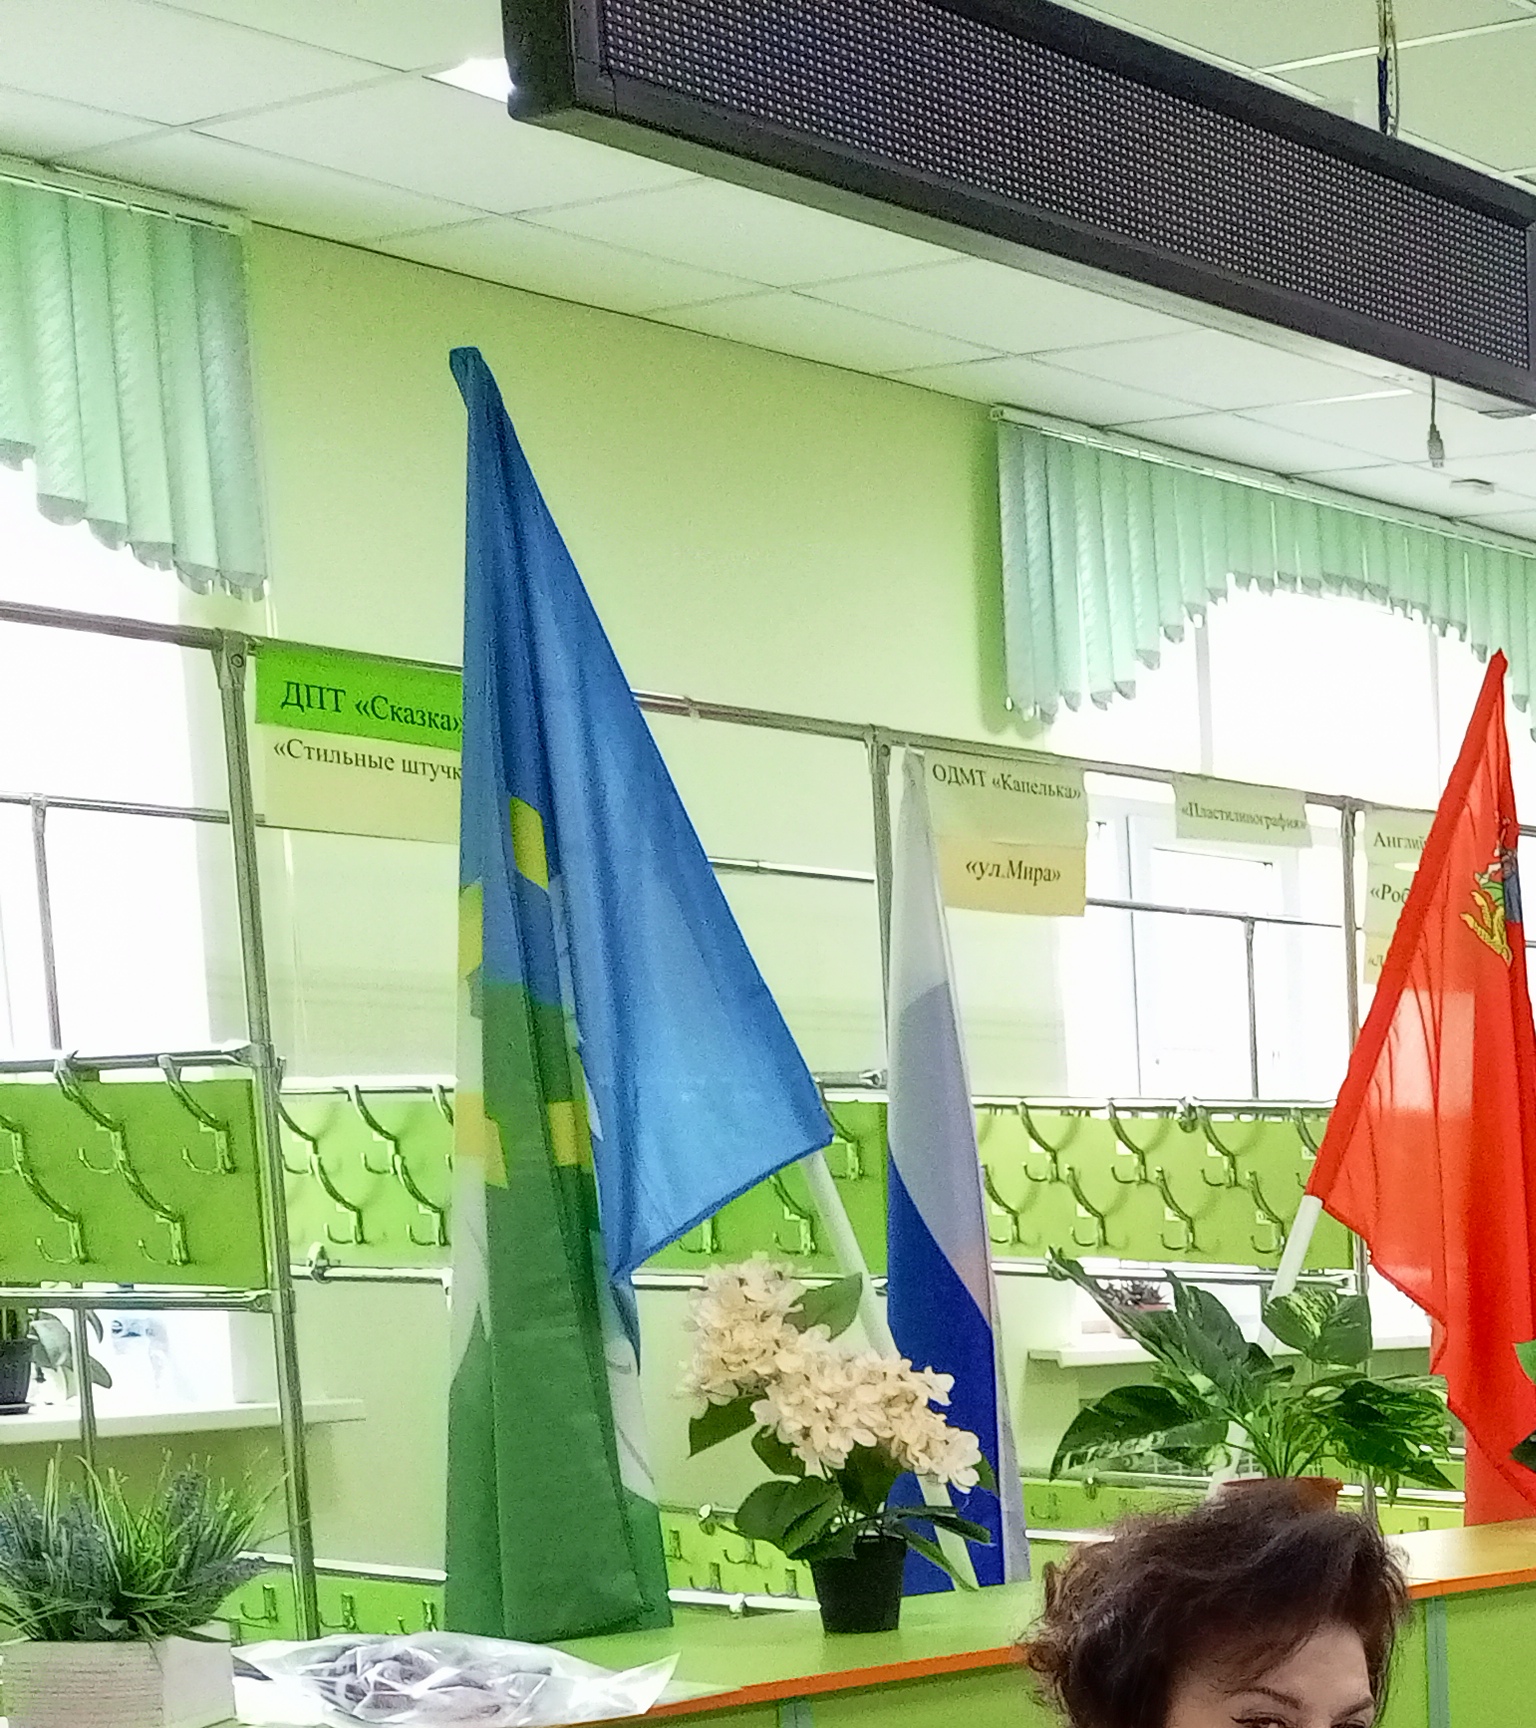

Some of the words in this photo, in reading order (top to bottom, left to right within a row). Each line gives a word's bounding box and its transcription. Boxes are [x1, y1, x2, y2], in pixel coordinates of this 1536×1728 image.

[281, 680, 346, 713] ДПТ
[355, 694, 462, 734] «Сказка»
[274, 738, 394, 771] «Стильные
[932, 763, 986, 788] ОДМТ
[992, 772, 1081, 799] «Капелька»
[966, 859, 1061, 887] «ул.Мира»
